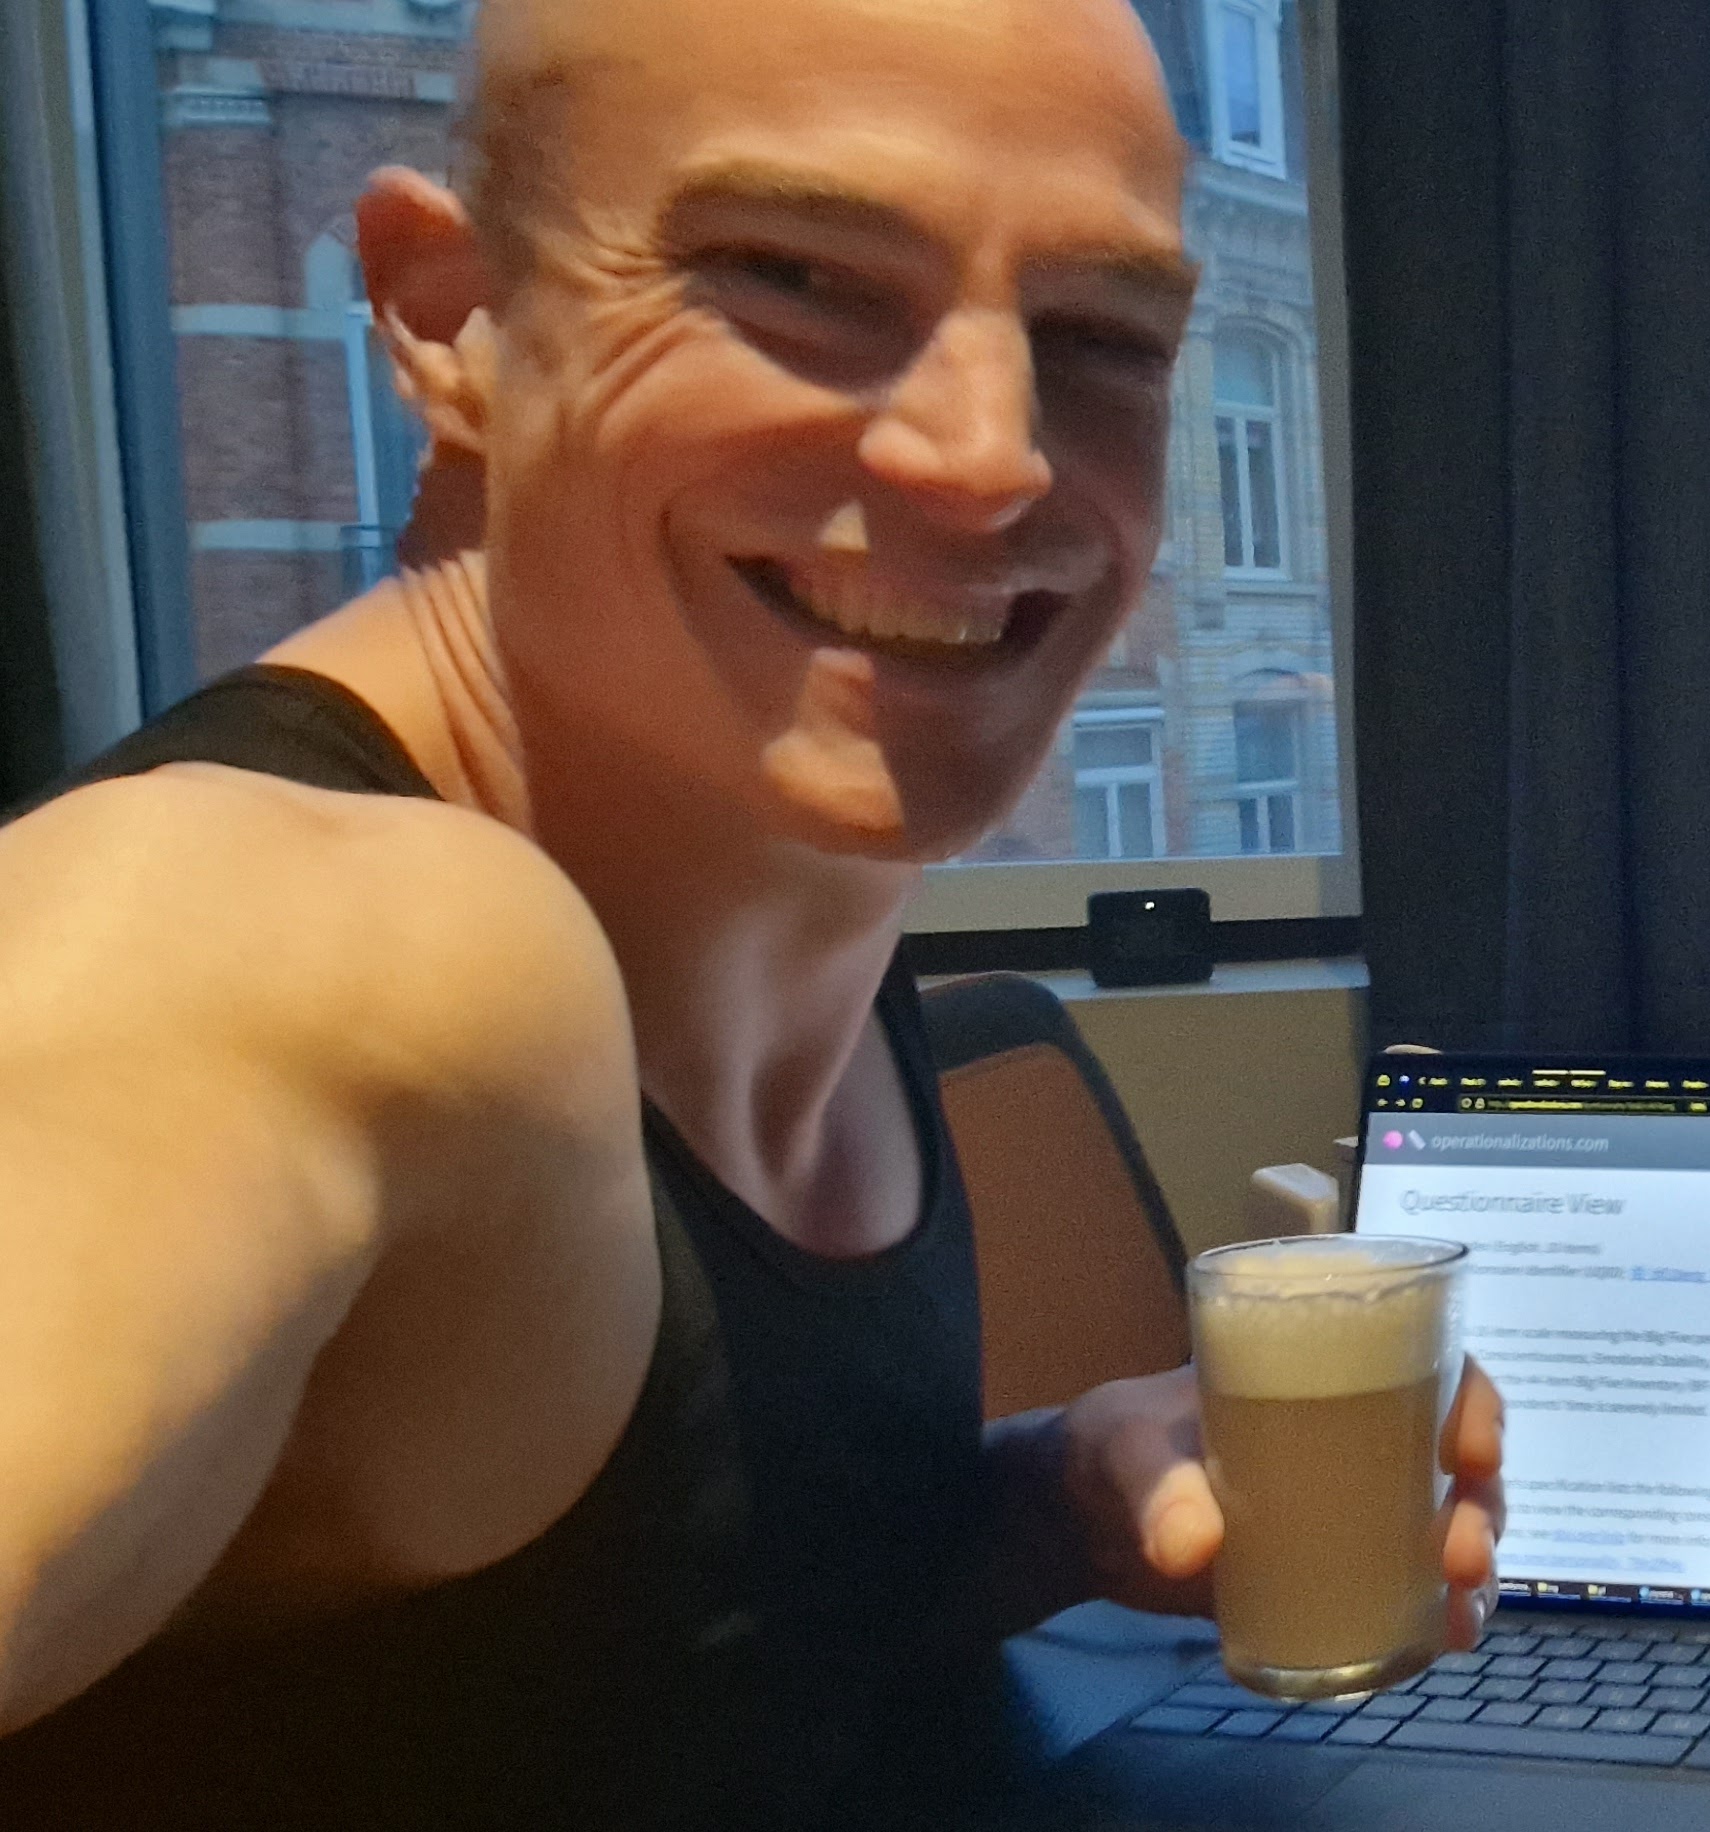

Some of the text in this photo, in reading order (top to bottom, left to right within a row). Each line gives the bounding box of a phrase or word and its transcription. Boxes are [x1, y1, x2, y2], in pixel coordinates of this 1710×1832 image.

[1432, 1133, 1610, 1152] operationalizations.com
[1400, 1190, 1628, 1215] Questionnaire View
